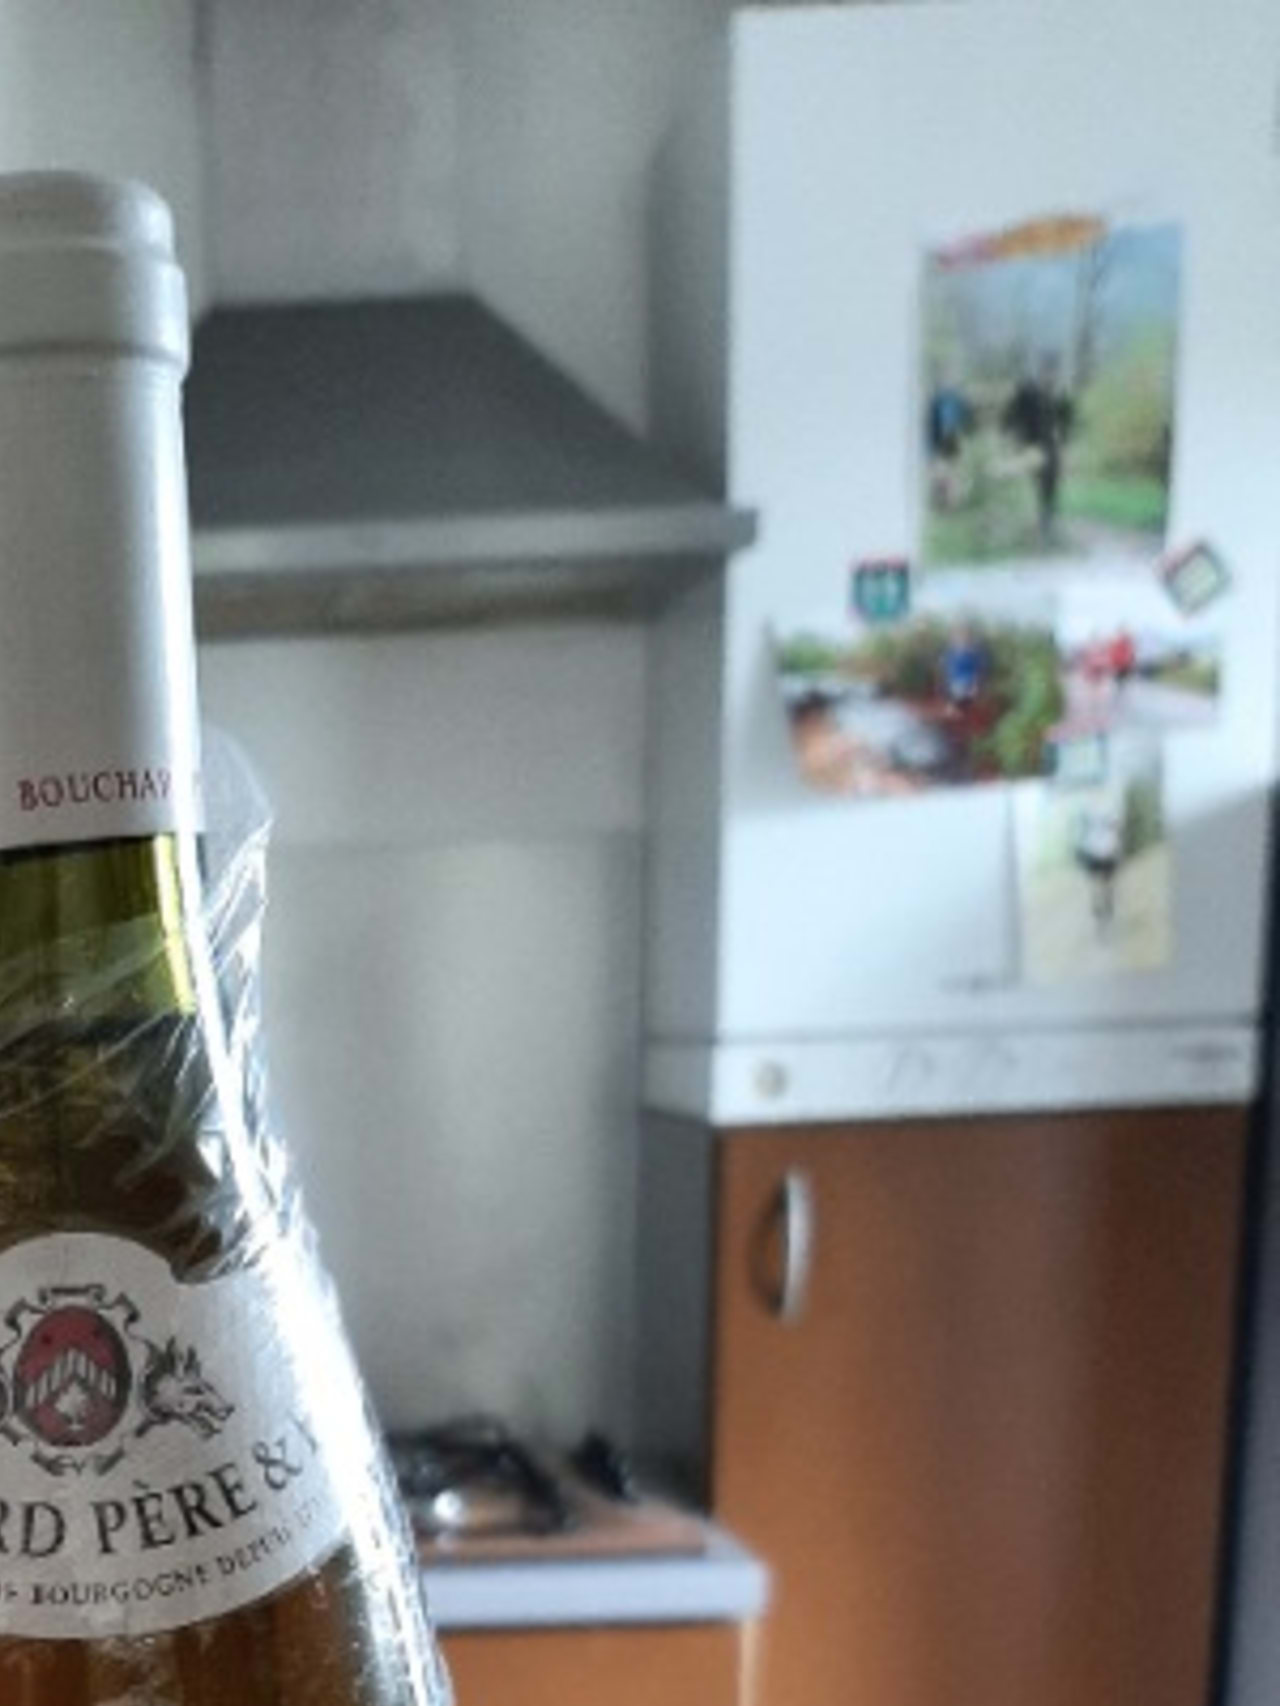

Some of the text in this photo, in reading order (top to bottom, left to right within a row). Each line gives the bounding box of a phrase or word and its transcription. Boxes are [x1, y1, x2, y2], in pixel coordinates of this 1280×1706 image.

[93, 1462, 258, 1556] PÈRE
[253, 1440, 305, 1490] &
[31, 1564, 210, 1605] BOURGOGNE
